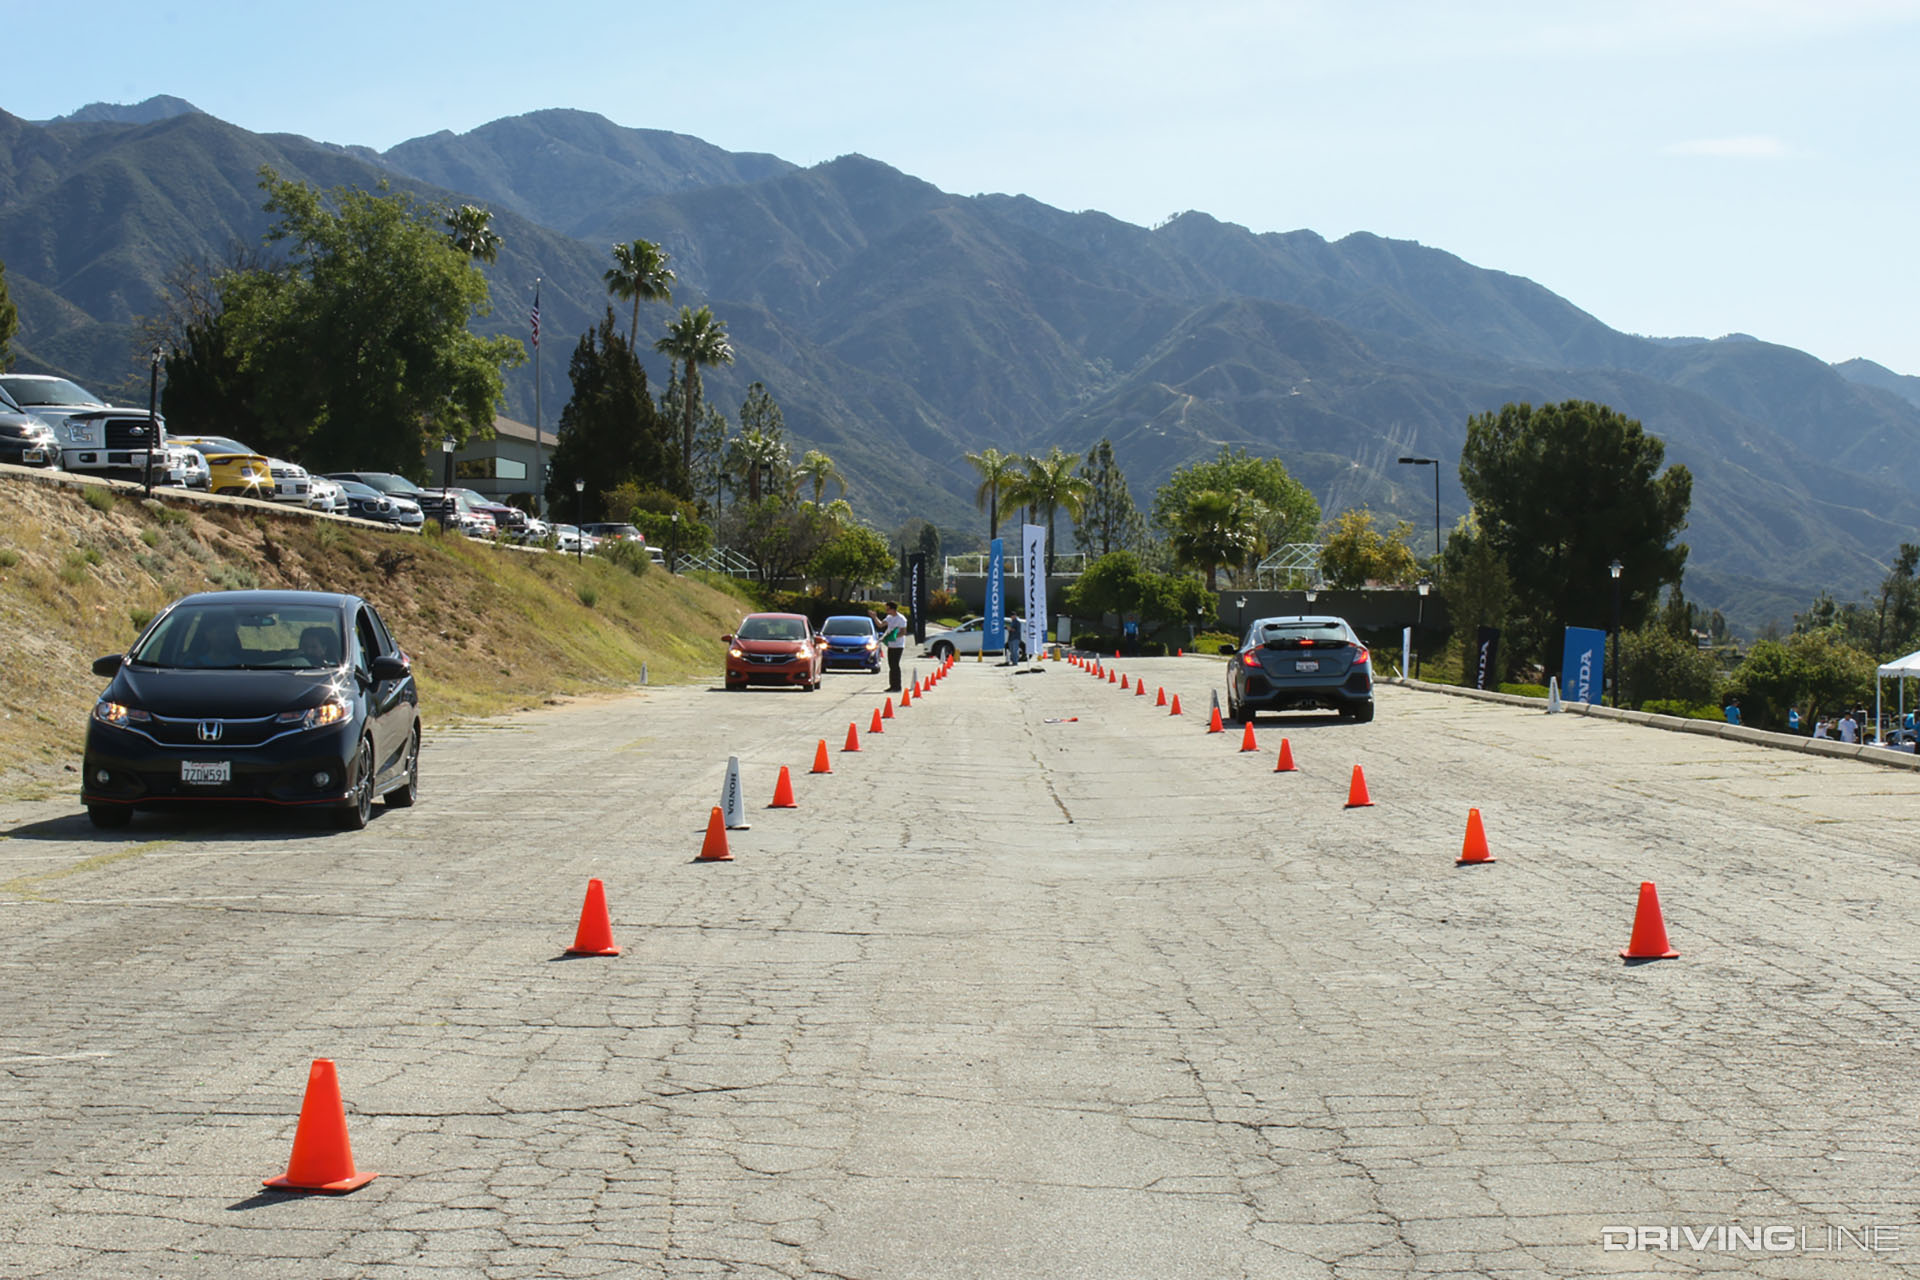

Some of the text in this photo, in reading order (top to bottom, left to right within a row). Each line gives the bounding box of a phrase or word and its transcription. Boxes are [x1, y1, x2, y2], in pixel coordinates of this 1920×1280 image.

[991, 555, 1000, 618] HONDA
[184, 768, 227, 782] 7ZDW591
[728, 773, 737, 816] HONDA
